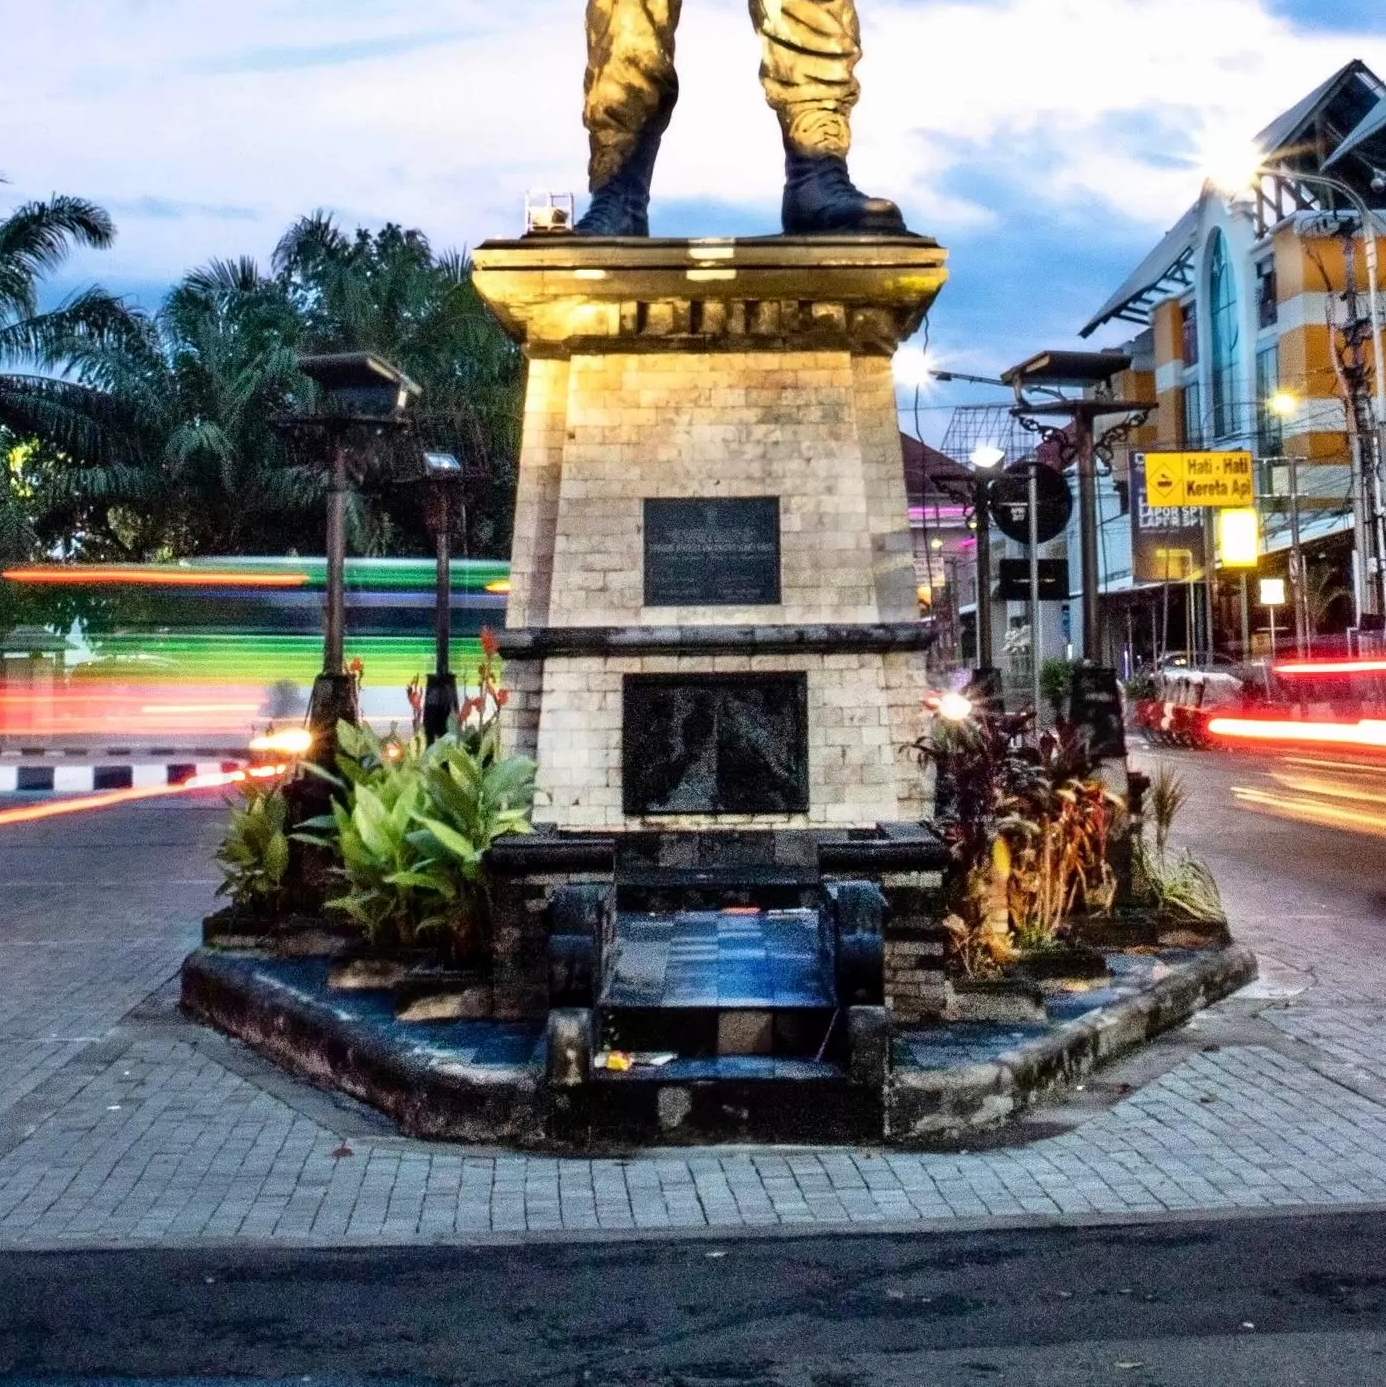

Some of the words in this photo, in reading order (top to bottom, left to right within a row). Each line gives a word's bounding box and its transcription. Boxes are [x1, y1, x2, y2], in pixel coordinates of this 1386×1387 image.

[1188, 458, 1213, 475] Hati
[1223, 457, 1248, 475] Hati
[1186, 479, 1228, 496] Kereta
[1232, 477, 1251, 499] Api
